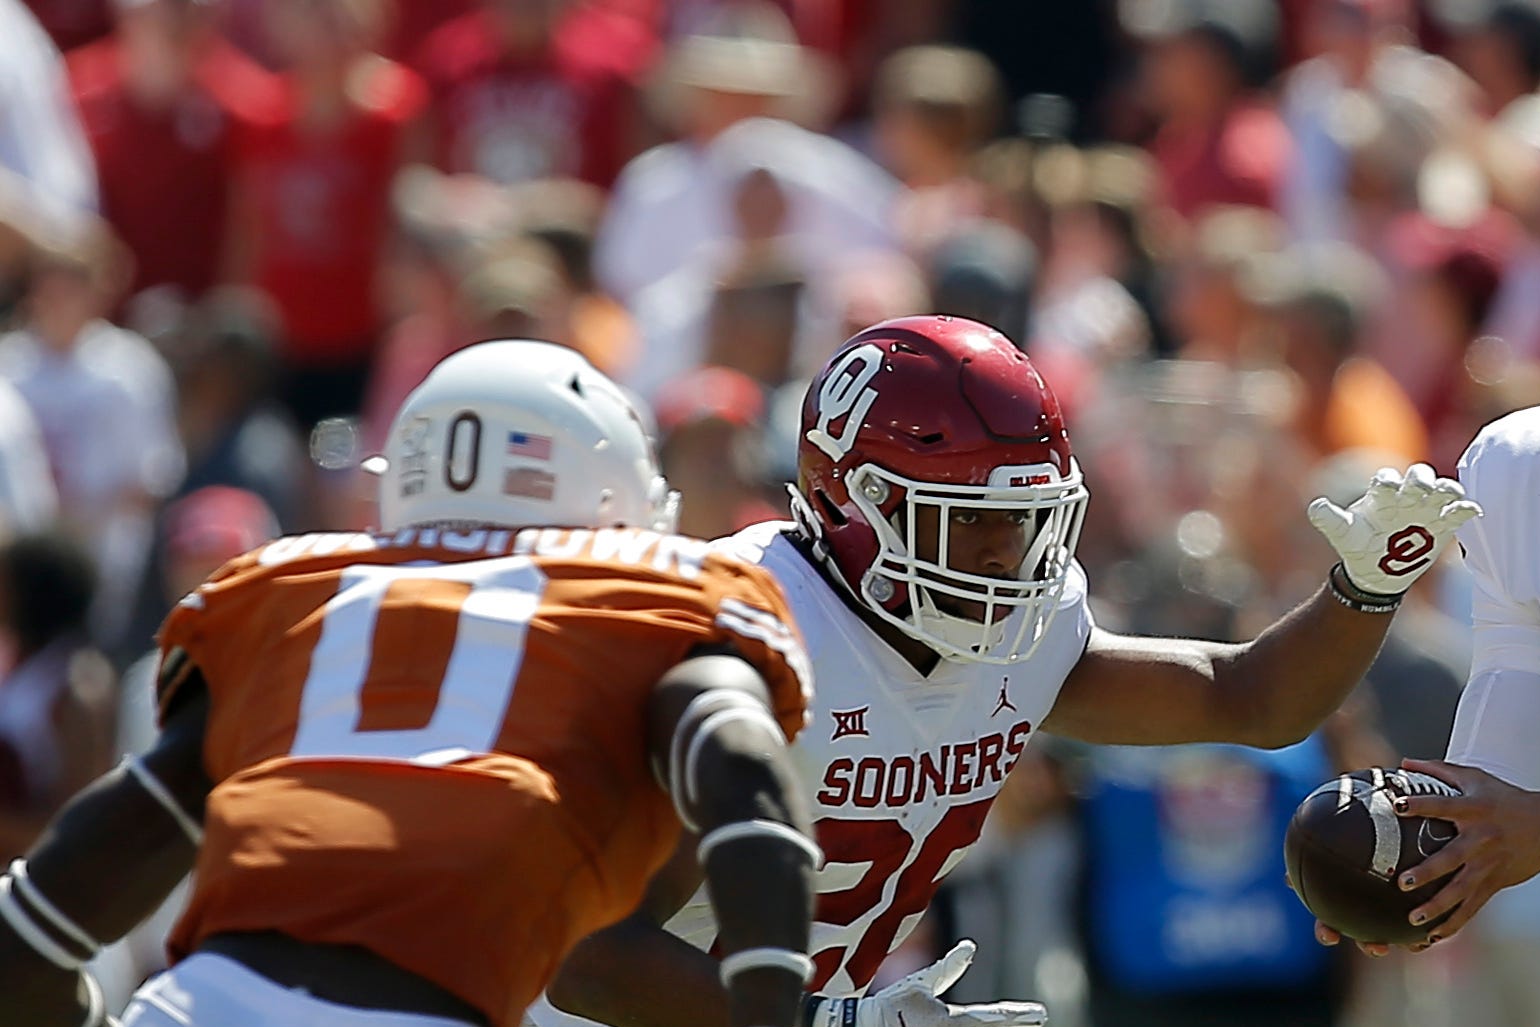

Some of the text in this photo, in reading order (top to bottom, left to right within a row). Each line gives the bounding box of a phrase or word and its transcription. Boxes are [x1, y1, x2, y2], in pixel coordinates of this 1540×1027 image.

[806, 343, 884, 463] OU
[445, 409, 483, 493] 0
[1378, 525, 1434, 577] OU
[816, 720, 1031, 808] SOONERS
[831, 706, 870, 741] XII
